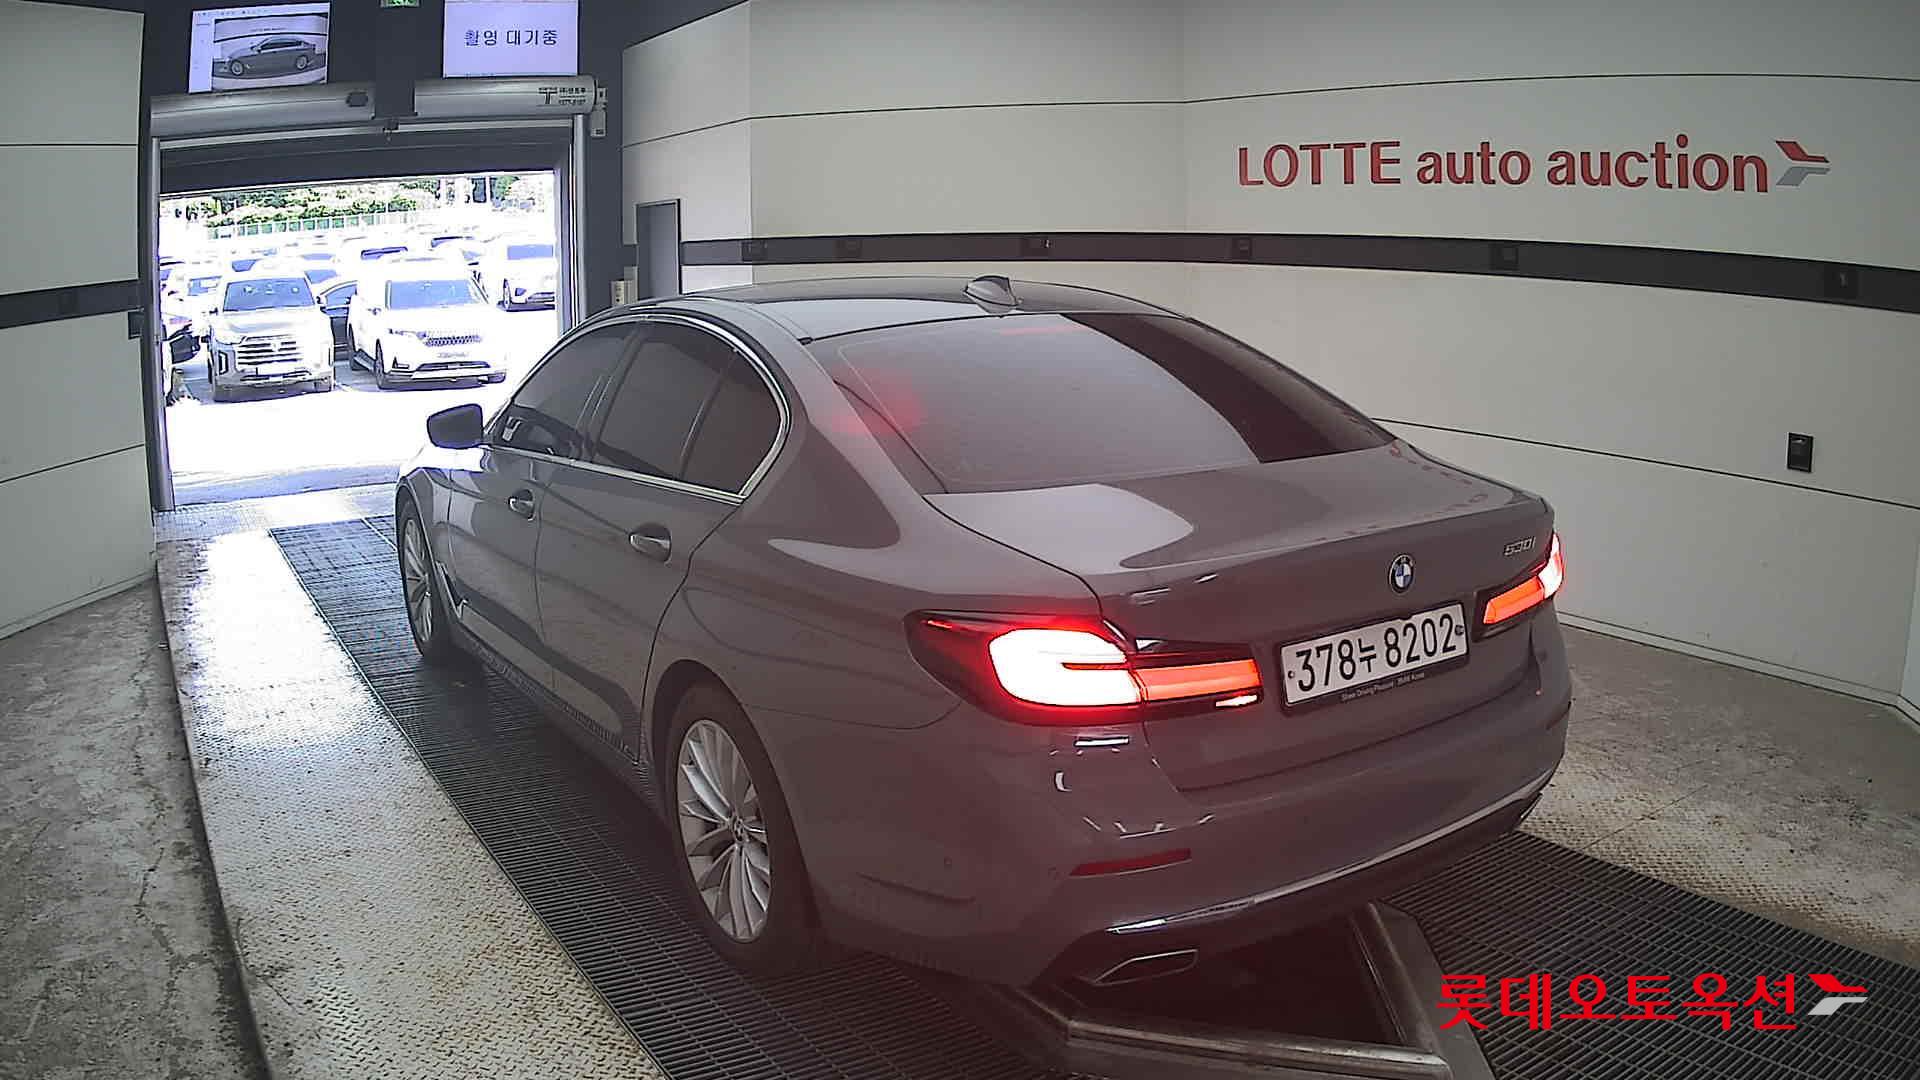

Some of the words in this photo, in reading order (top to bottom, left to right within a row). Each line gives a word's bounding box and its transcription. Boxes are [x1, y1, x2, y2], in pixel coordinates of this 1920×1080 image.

[464, 29, 498, 47] 촬영
[506, 29, 559, 46] 대기중
[1238, 141, 1400, 187] LOTTE
[1416, 141, 1531, 185] auto
[1547, 134, 1768, 192] auction
[1295, 638, 1377, 692] 378누
[1384, 613, 1457, 668] 8202
